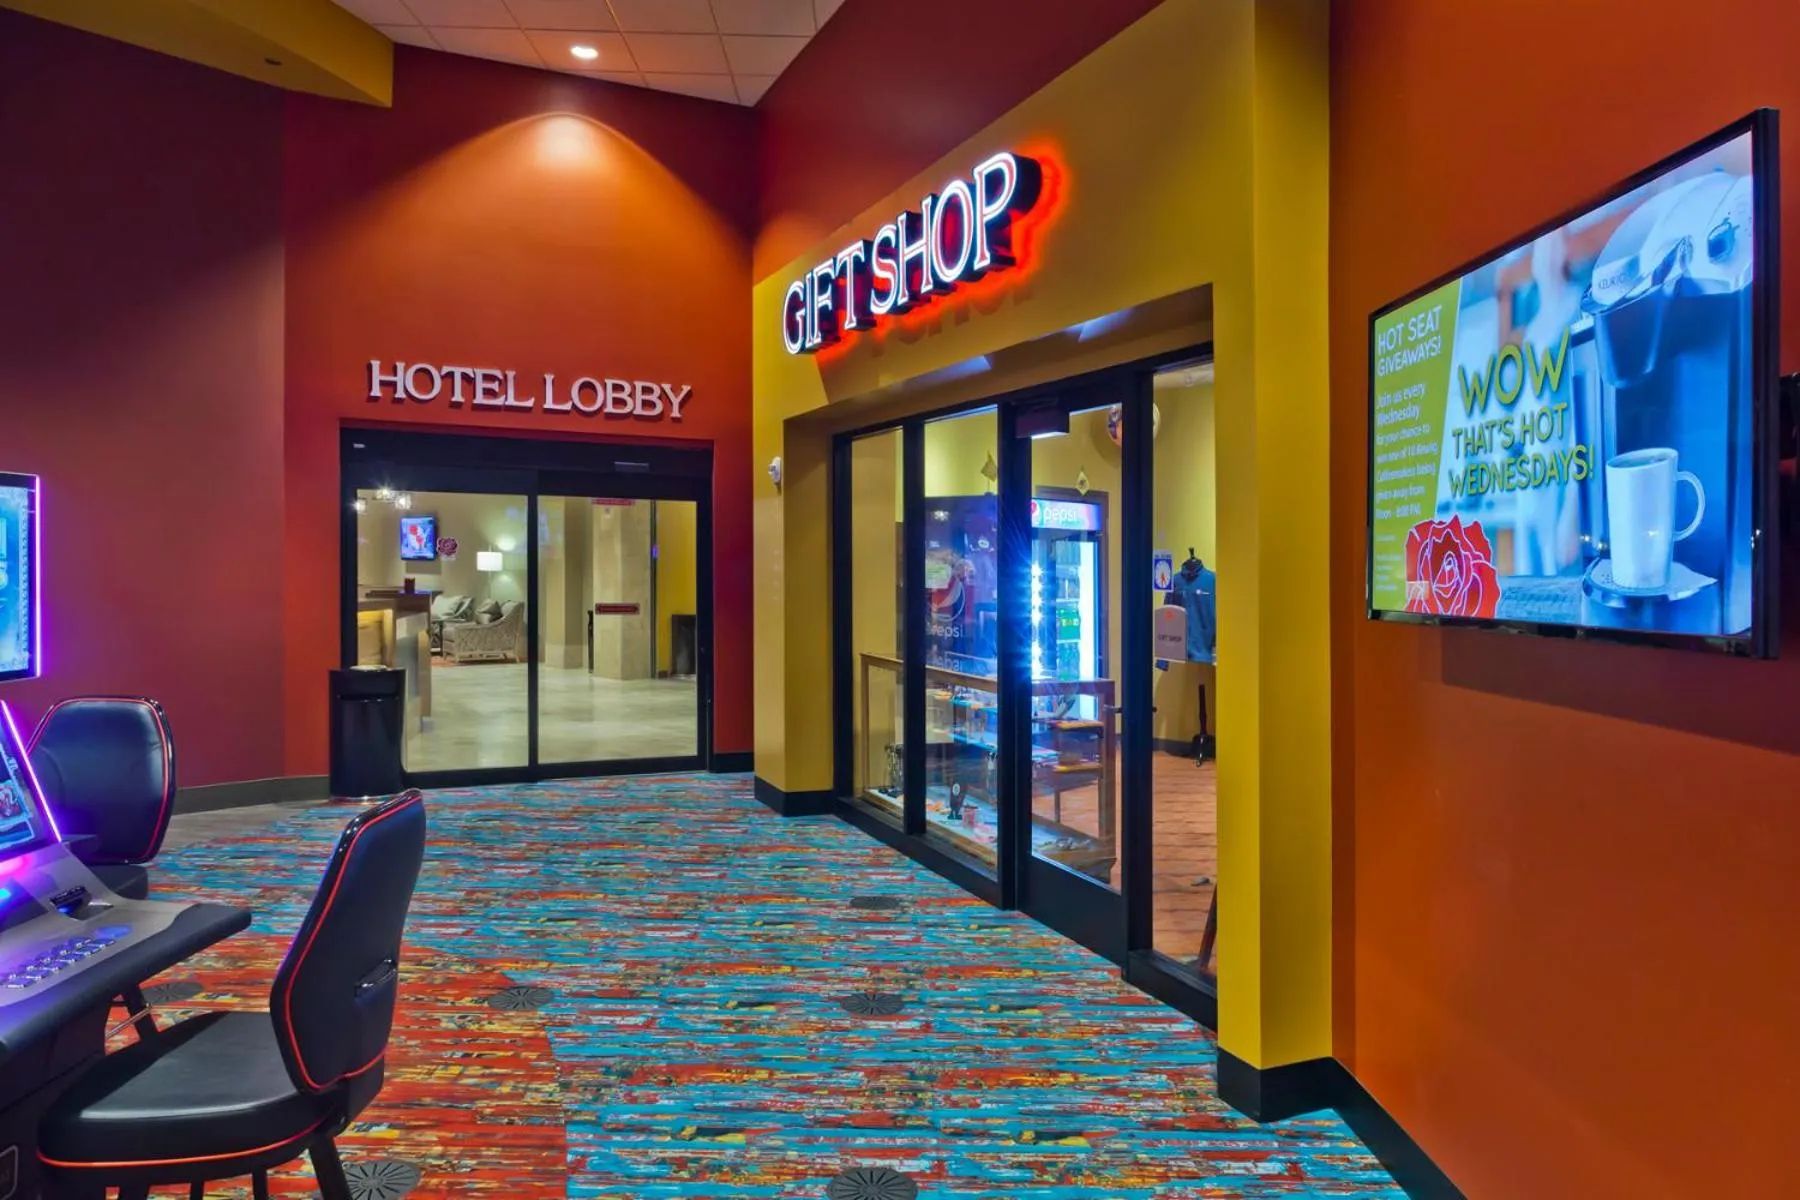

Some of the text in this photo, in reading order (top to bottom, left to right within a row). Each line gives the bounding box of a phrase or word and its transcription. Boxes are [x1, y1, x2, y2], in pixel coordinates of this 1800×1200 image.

[783, 152, 1028, 354] GIFT SHOP
[1377, 335, 1441, 377] GIVEAWAYS!
[1378, 304, 1442, 355] HOT SEAT
[369, 360, 691, 418] HOTEL LOBBY
[1458, 325, 1570, 417] WOW
[1452, 402, 1568, 459] THAT'S HOT
[1448, 444, 1595, 498] WEDNESDAYS!
[1043, 507, 1076, 525] pepsi
